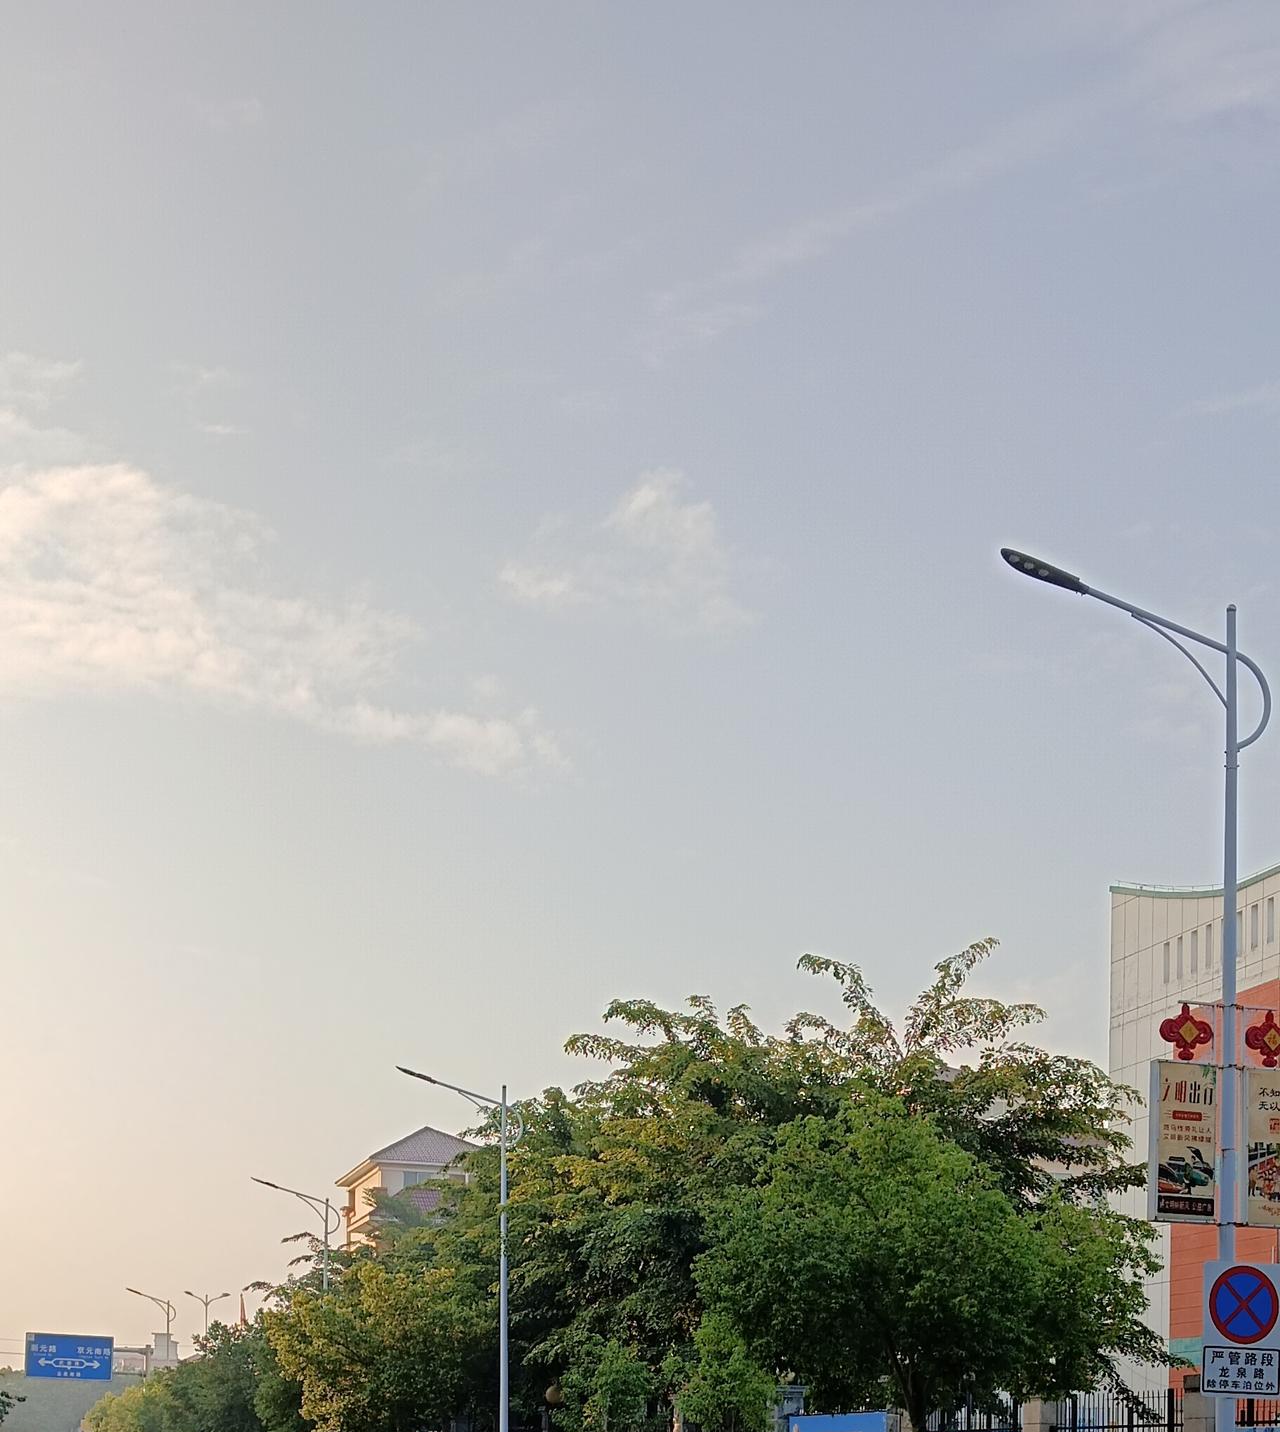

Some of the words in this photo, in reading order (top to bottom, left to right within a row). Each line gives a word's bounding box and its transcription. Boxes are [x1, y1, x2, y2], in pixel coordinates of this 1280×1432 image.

[1211, 1351, 1274, 1366] 严管路段
[1219, 1366, 1264, 1379] 龙泉路
[1206, 1379, 1275, 1391] 除停车泊位外
